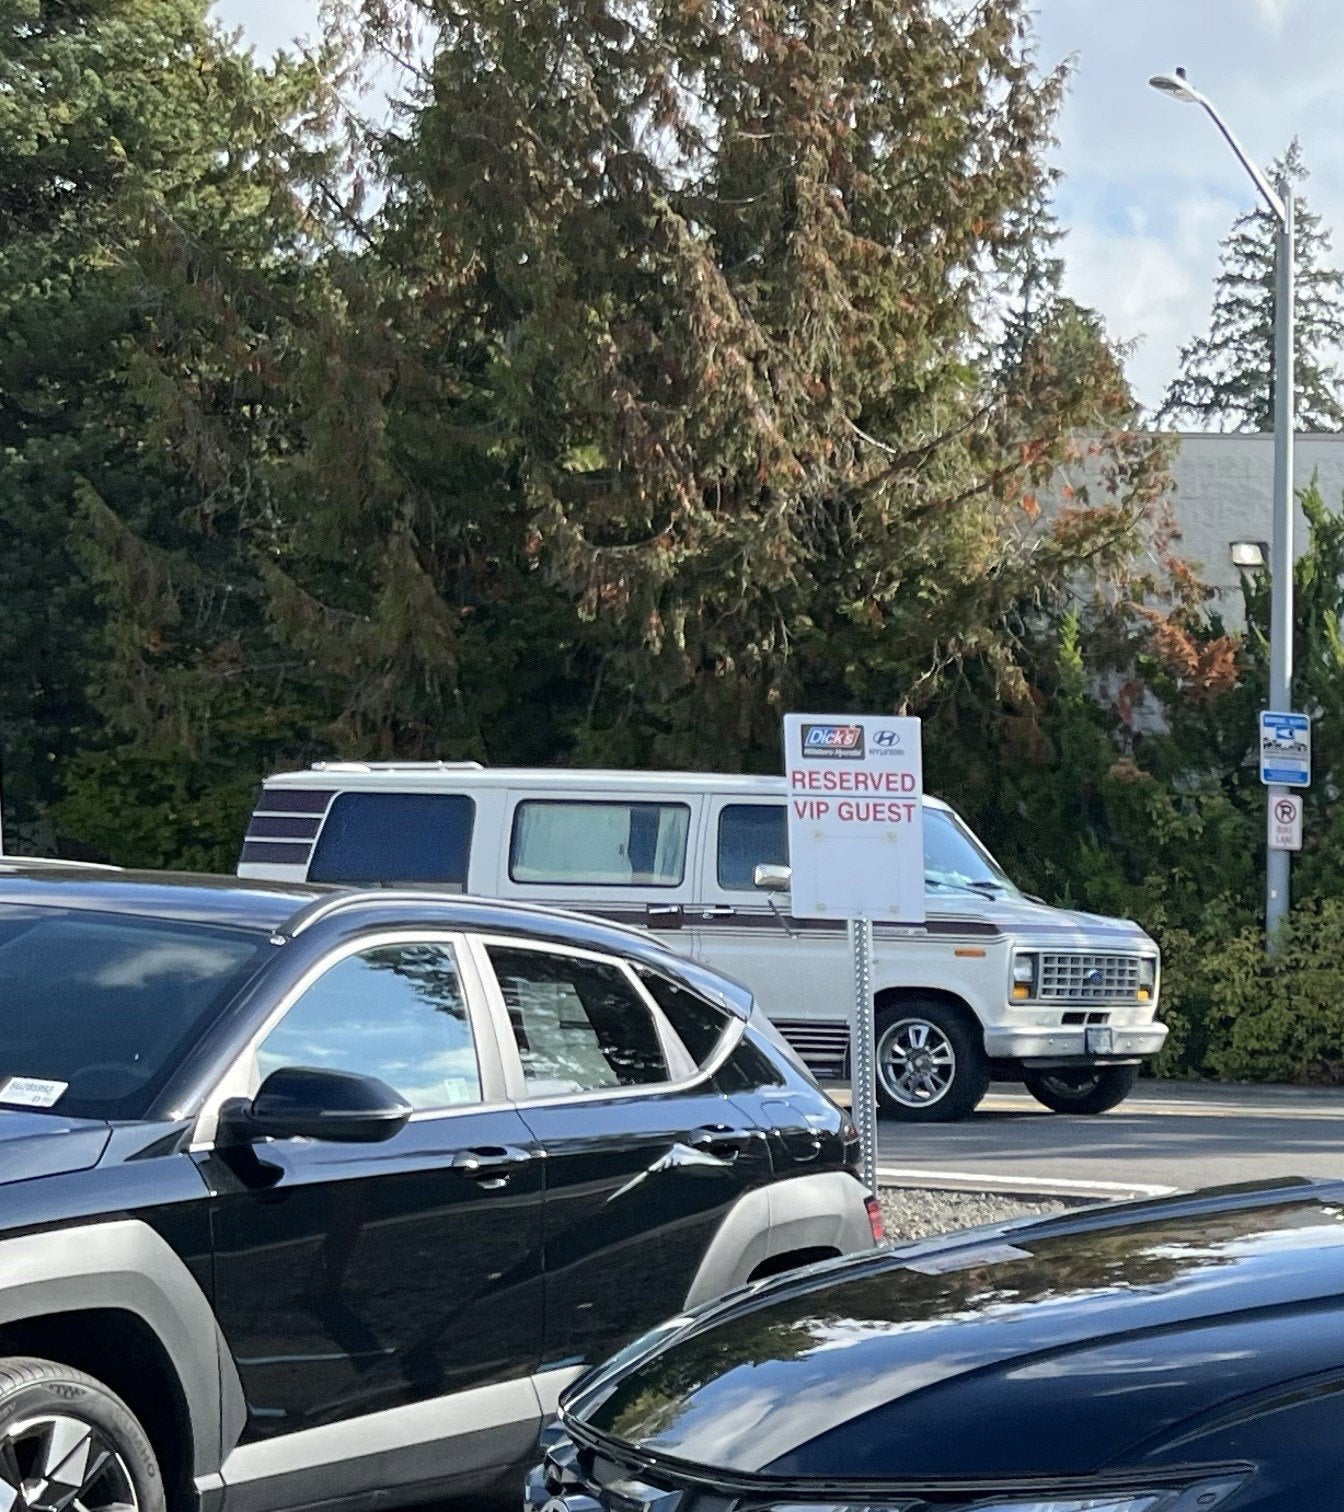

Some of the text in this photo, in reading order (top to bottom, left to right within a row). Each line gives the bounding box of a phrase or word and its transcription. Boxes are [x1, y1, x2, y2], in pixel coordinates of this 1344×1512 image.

[791, 770, 917, 792] RESERVED
[794, 800, 917, 823] VIP GUEST
